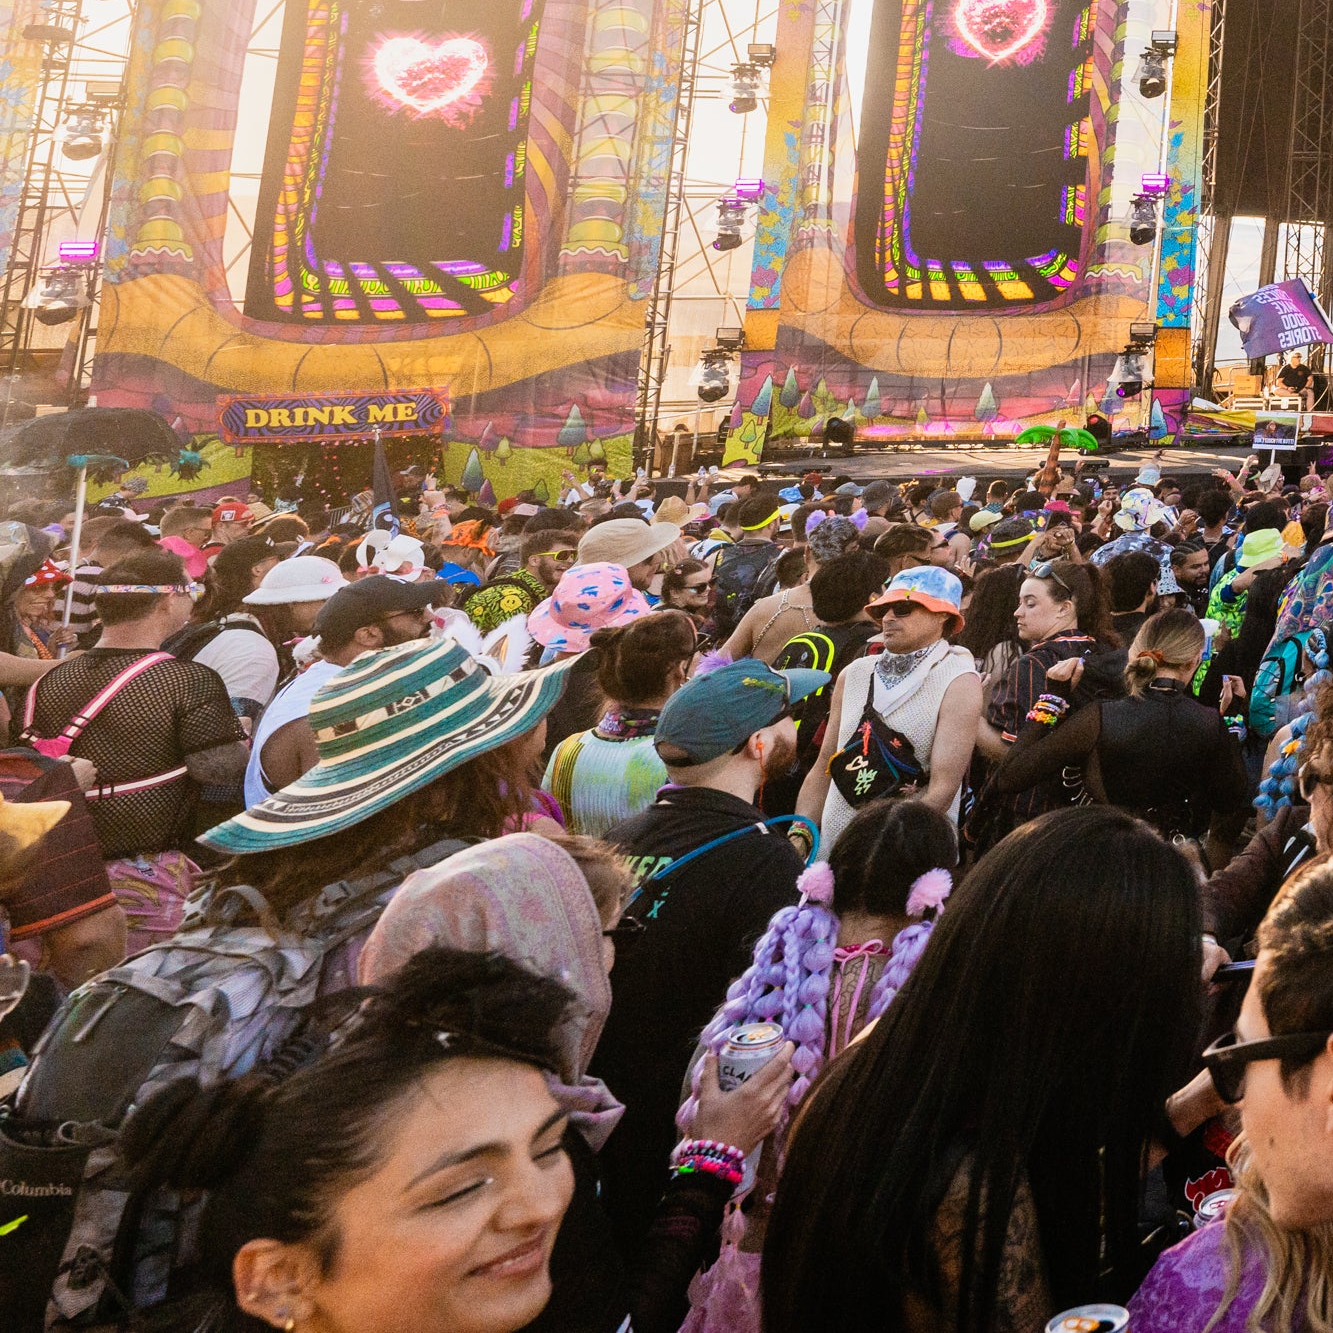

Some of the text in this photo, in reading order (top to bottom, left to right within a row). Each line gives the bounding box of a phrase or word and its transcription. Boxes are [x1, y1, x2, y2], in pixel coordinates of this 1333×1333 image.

[245, 402, 419, 428] DRINK ME
[1, 1179, 73, 1197] Columbia
